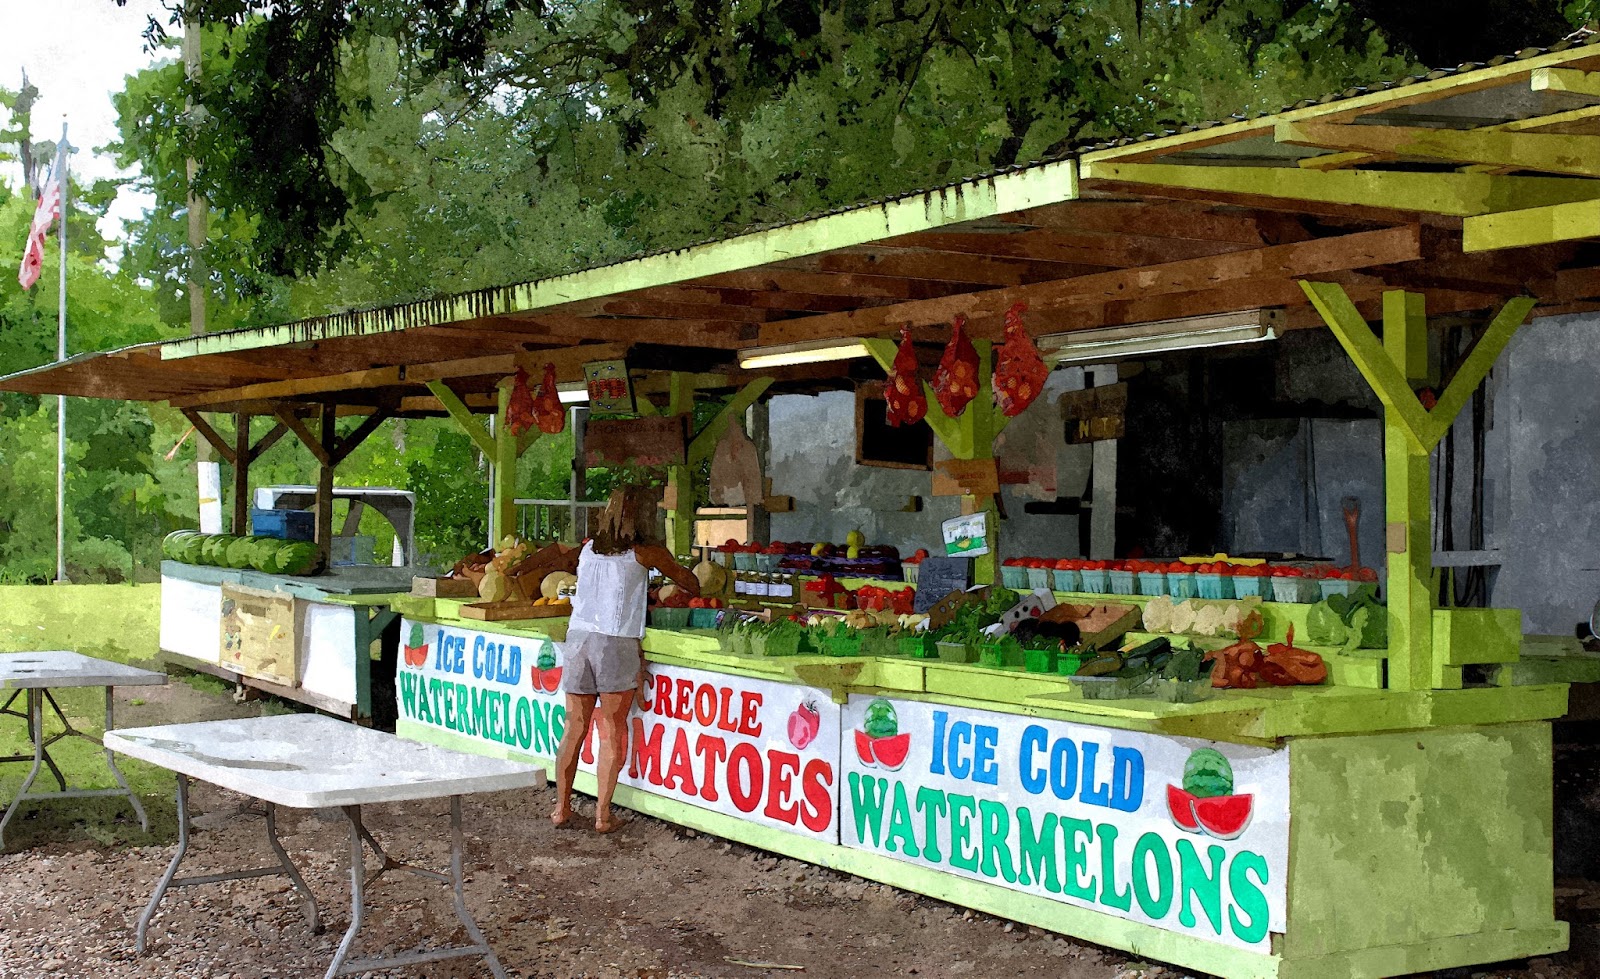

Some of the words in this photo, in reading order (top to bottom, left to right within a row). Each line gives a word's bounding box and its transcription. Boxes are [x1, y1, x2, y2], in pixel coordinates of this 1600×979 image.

[434, 629, 465, 674] ICE
[472, 634, 522, 686] COLD
[637, 670, 763, 737] CREOLE
[399, 671, 566, 757] WATERMELONS
[581, 706, 833, 833] TMATOES
[929, 710, 999, 785] ICE
[1018, 724, 1145, 813] COLD
[848, 771, 1269, 944] WATERMELONS
